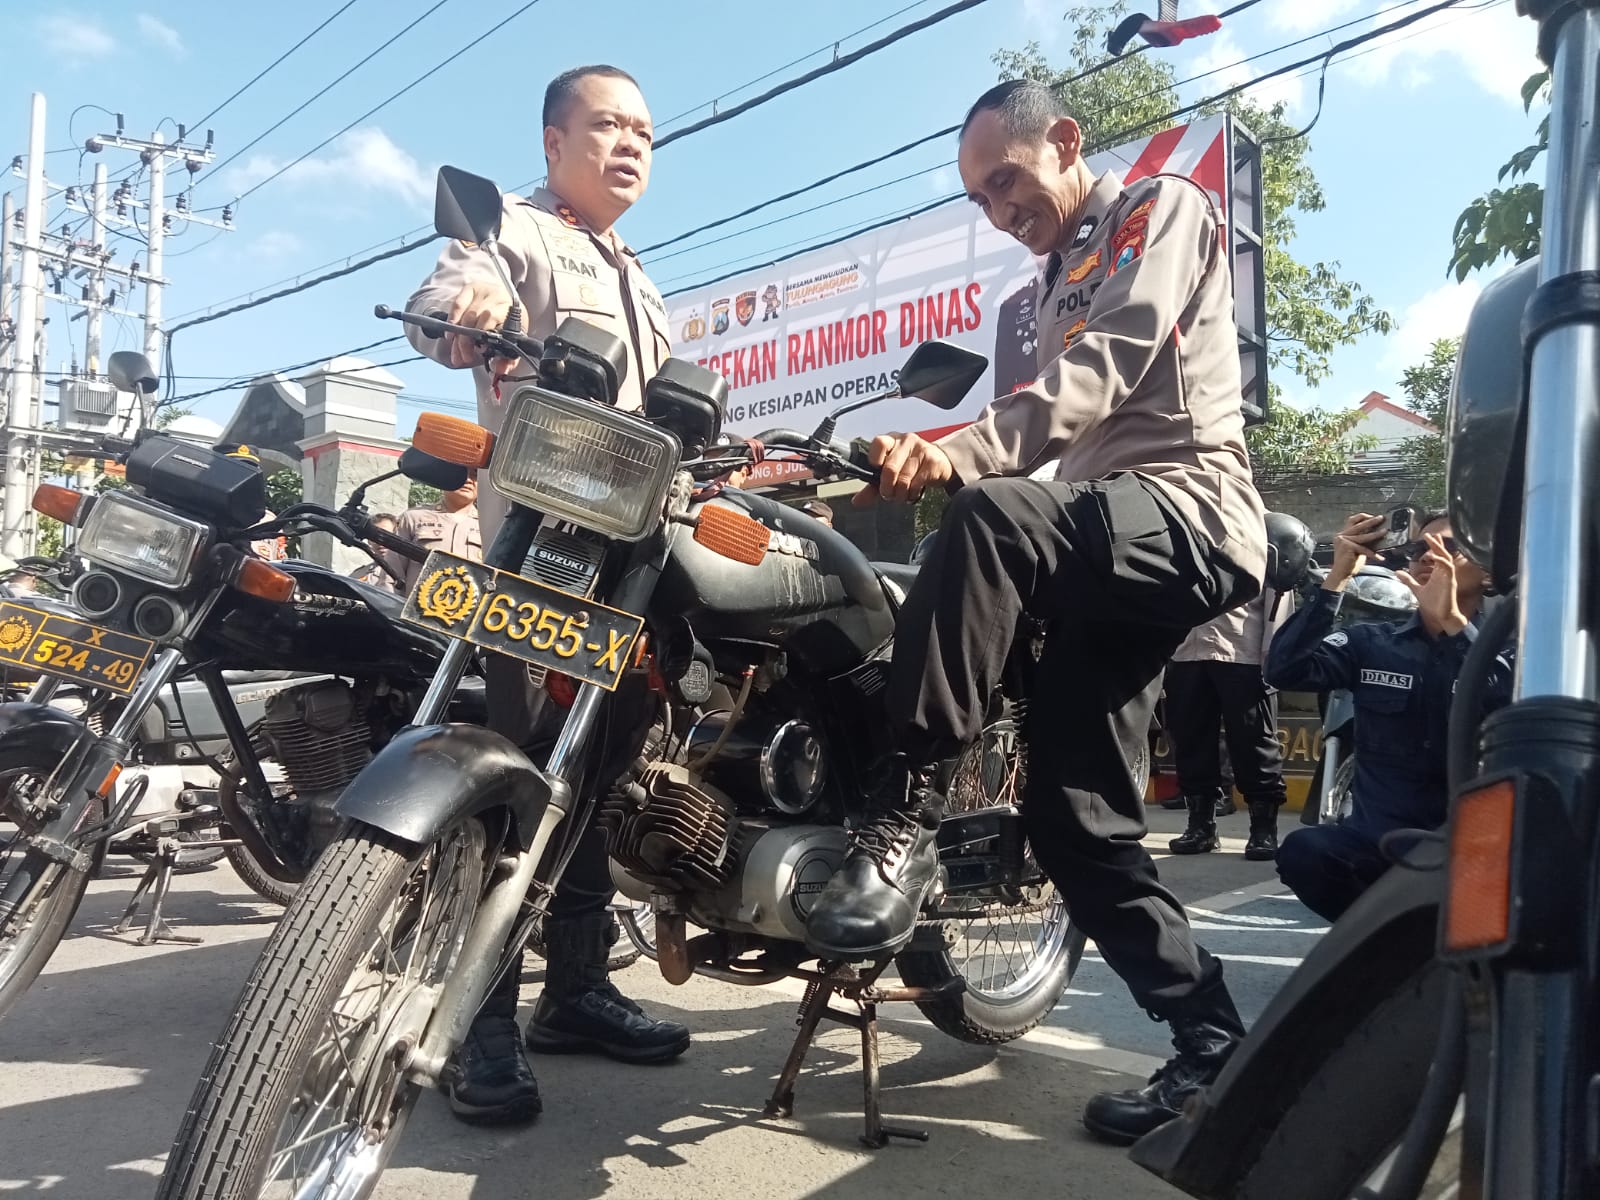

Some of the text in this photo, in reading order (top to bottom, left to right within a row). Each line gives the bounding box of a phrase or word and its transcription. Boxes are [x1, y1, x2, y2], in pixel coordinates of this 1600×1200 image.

[557, 255, 597, 279] TAAT
[786, 263, 859, 291] BERSAMA MEWUJUDKAN
[787, 310, 887, 376] RANMOR
[900, 282, 981, 348] DINAS
[722, 406, 745, 425] NG
[748, 386, 827, 419] KESIAPAN
[776, 463, 783, 476] 9
[538, 550, 585, 571] SUZUKI
[85, 629, 108, 646] X
[483, 594, 630, 673] 6355-X
[1365, 671, 1408, 687] DIMAS
